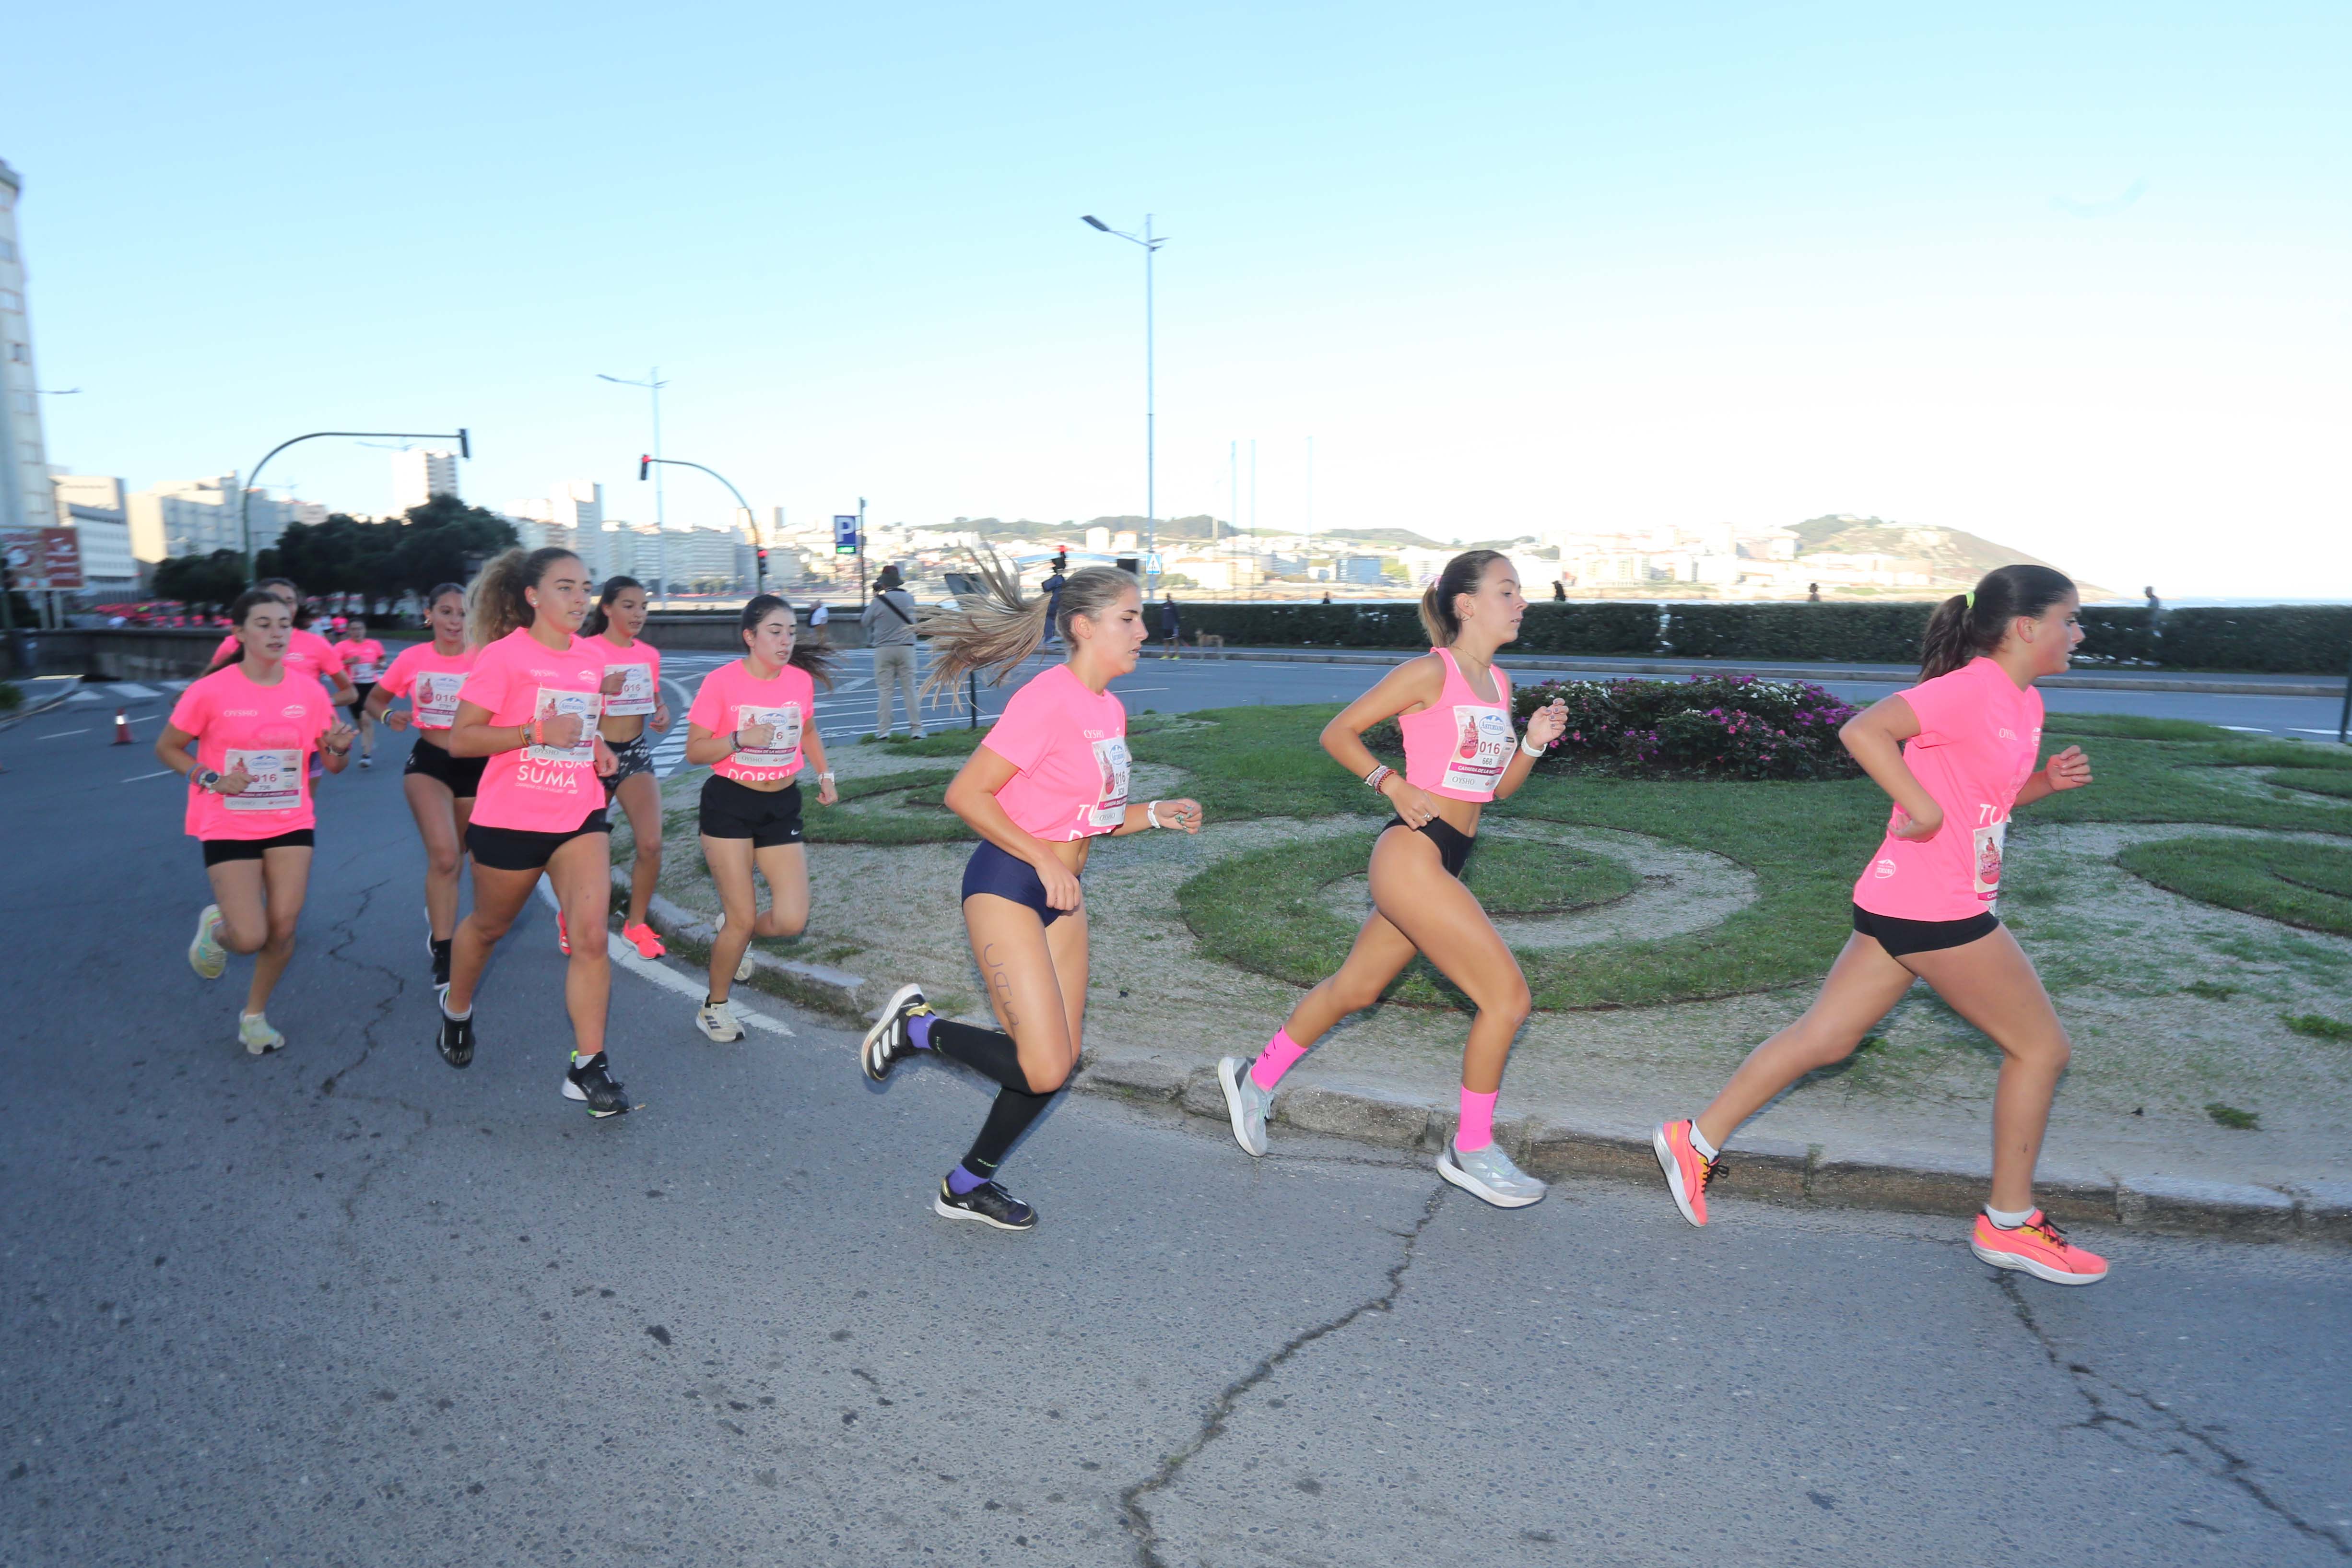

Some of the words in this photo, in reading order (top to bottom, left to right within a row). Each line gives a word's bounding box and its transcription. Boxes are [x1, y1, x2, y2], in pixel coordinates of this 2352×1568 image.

[835, 518, 854, 542] P
[435, 694, 456, 703] 016
[534, 747, 559, 755] OYSHO
[1480, 742, 1500, 755] 016
[1482, 757, 1493, 766] 668
[517, 766, 577, 788] SUMA
[1115, 771, 1126, 785] 016
[1452, 776, 1475, 785] OYSHO
[1099, 813, 1116, 822] OYSHO
